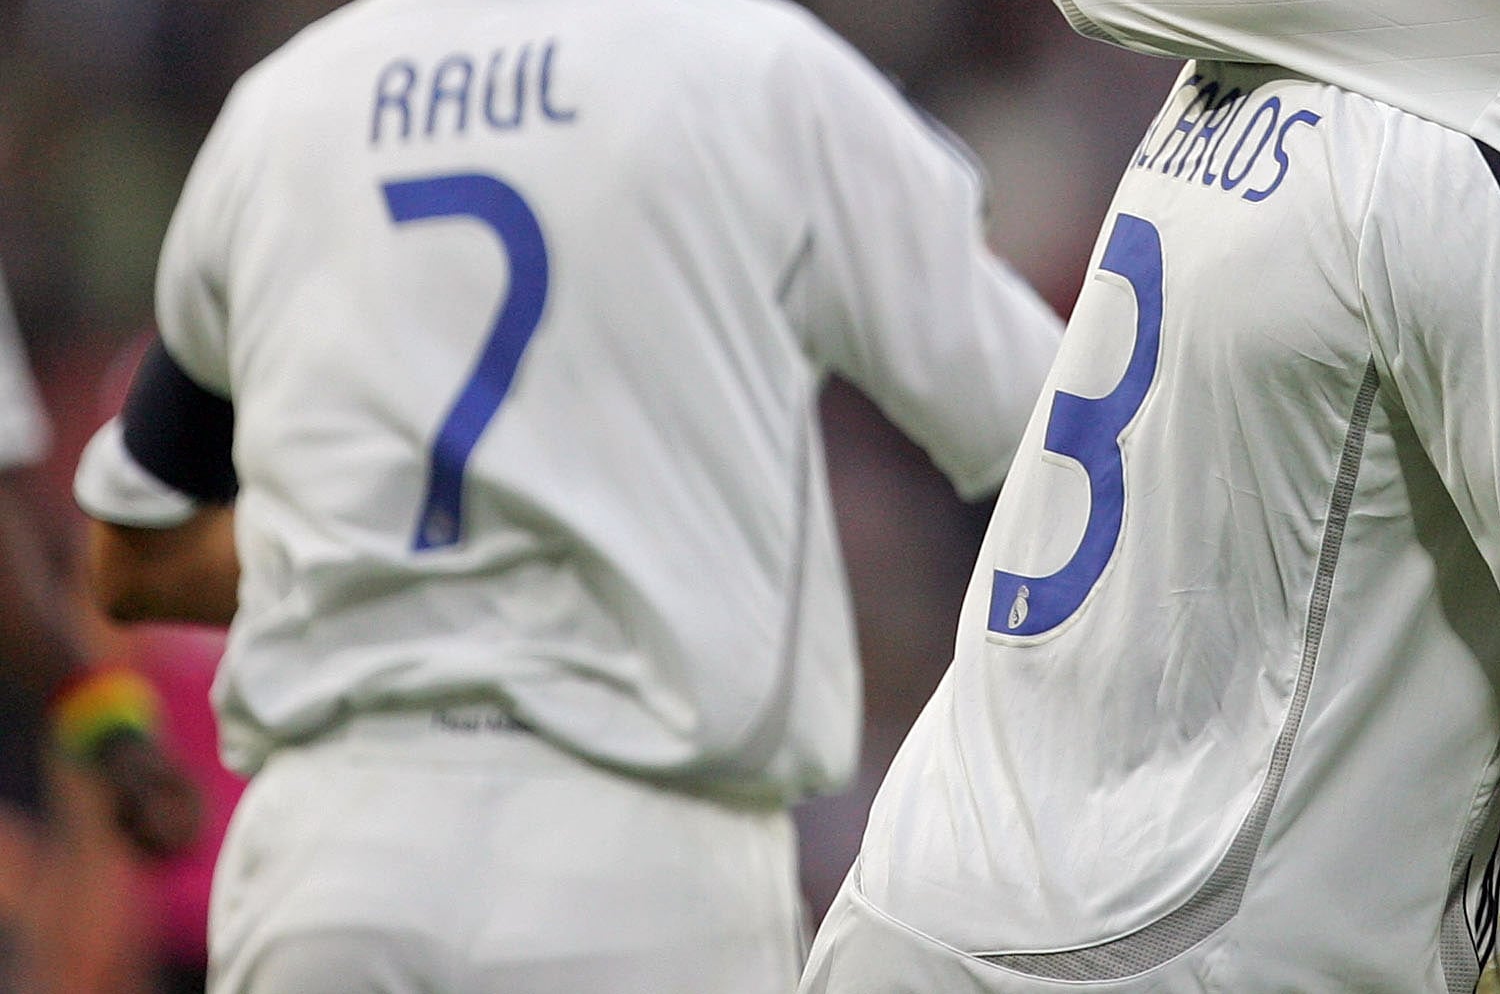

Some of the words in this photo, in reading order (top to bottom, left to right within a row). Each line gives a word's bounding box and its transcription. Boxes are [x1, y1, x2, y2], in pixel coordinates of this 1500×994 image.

[369, 38, 577, 146] RAUL
[381, 173, 550, 553] 7
[987, 212, 1163, 636] 3
